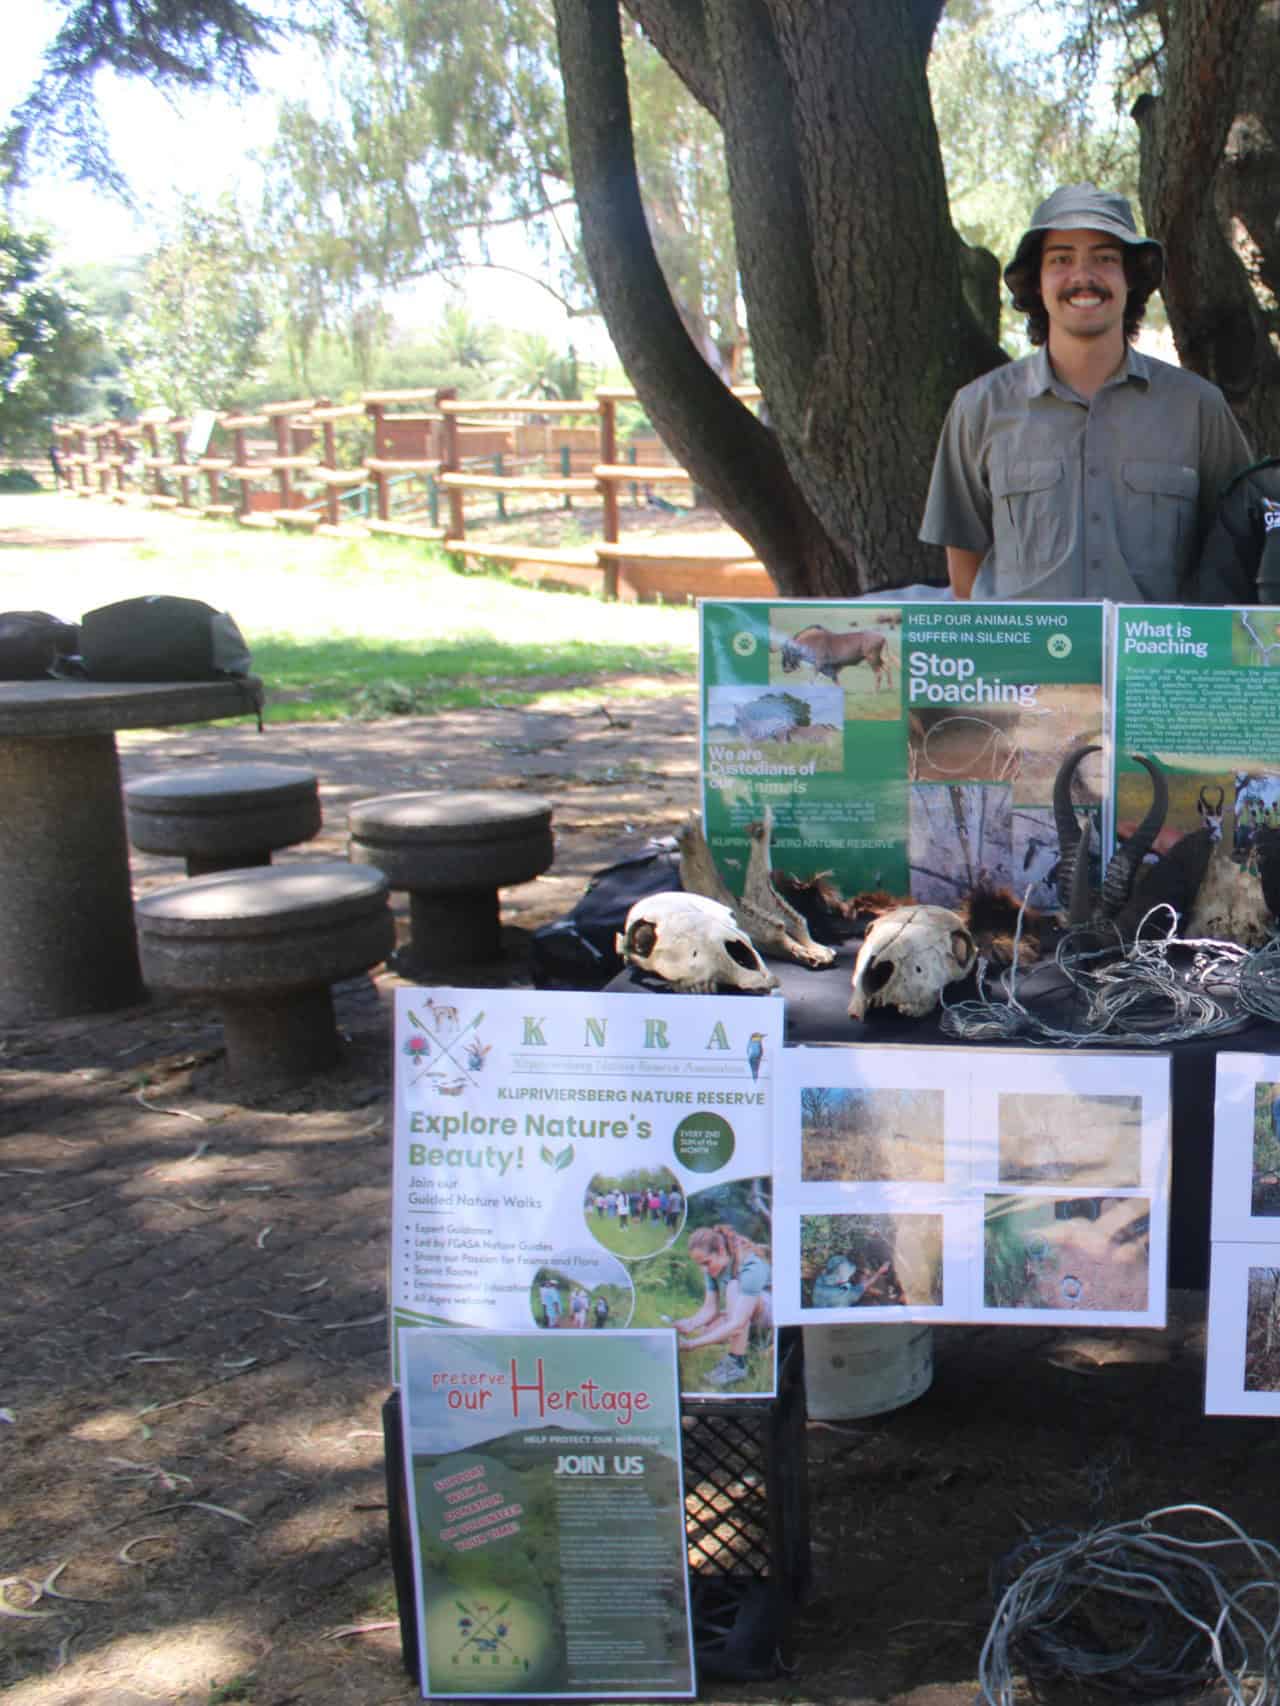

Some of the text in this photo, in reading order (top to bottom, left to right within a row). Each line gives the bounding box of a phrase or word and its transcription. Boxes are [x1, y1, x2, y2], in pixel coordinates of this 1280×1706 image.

[908, 614, 1068, 626] HELP OUR ANIMALS WHO
[1124, 621, 1192, 638] What is
[908, 631, 1031, 643] SUFFER IN SILENCE
[1124, 638, 1209, 658] Poaching
[908, 651, 975, 681] Stop
[909, 677, 1040, 708] Poaching
[709, 746, 763, 761] We are
[709, 761, 817, 776] Custodians of
[497, 1086, 766, 1105] KLIPRIVIERSBERG NATURE RESERVE
[409, 1111, 652, 1141] Explore Nature's
[408, 1143, 524, 1176] Beauty!
[408, 1175, 434, 1189] Join
[408, 1191, 543, 1209] Guided Nature Walks
[432, 1372, 505, 1391] preserve
[447, 1358, 651, 1426] our Heritage
[554, 1455, 645, 1475] JOIN US
